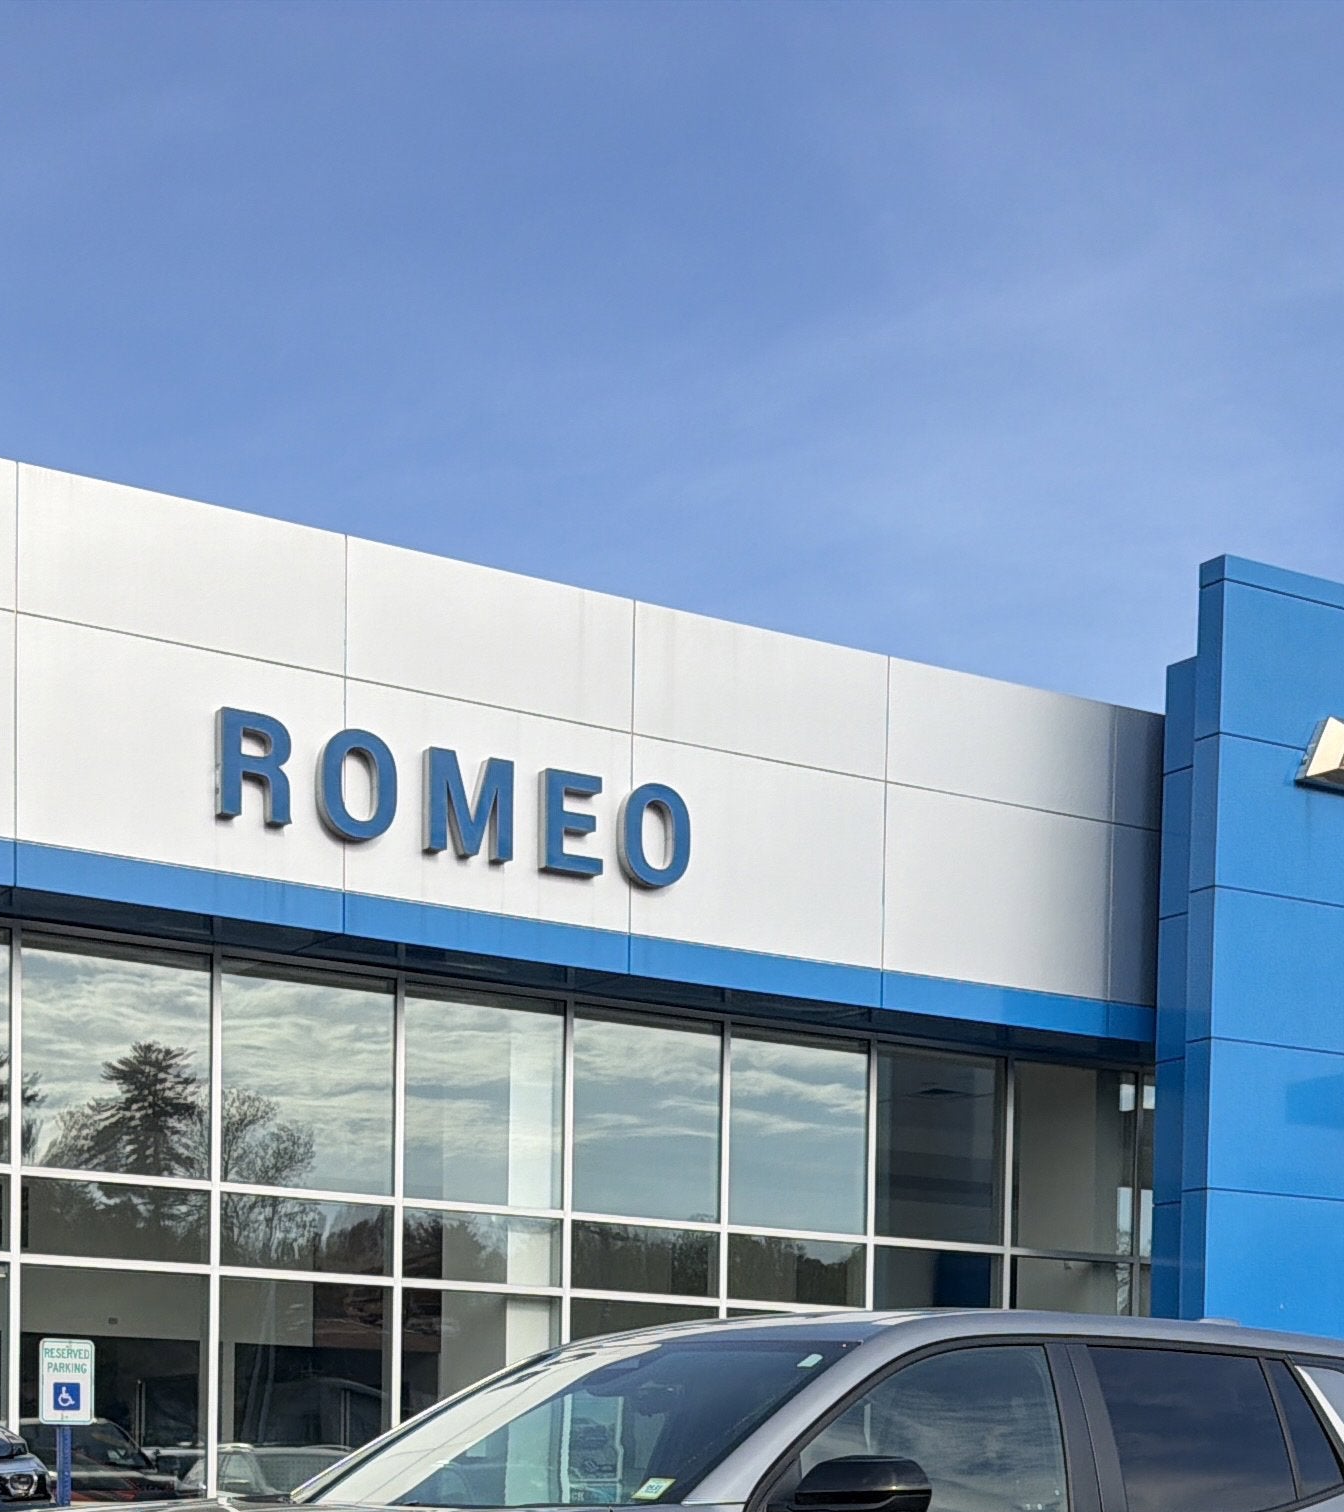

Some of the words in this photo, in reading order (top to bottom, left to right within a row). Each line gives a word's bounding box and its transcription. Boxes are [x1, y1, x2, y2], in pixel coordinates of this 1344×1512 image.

[215, 705, 691, 889] ROMEO
[44, 1347, 90, 1360] RESERVED
[47, 1362, 87, 1375] PARKING
